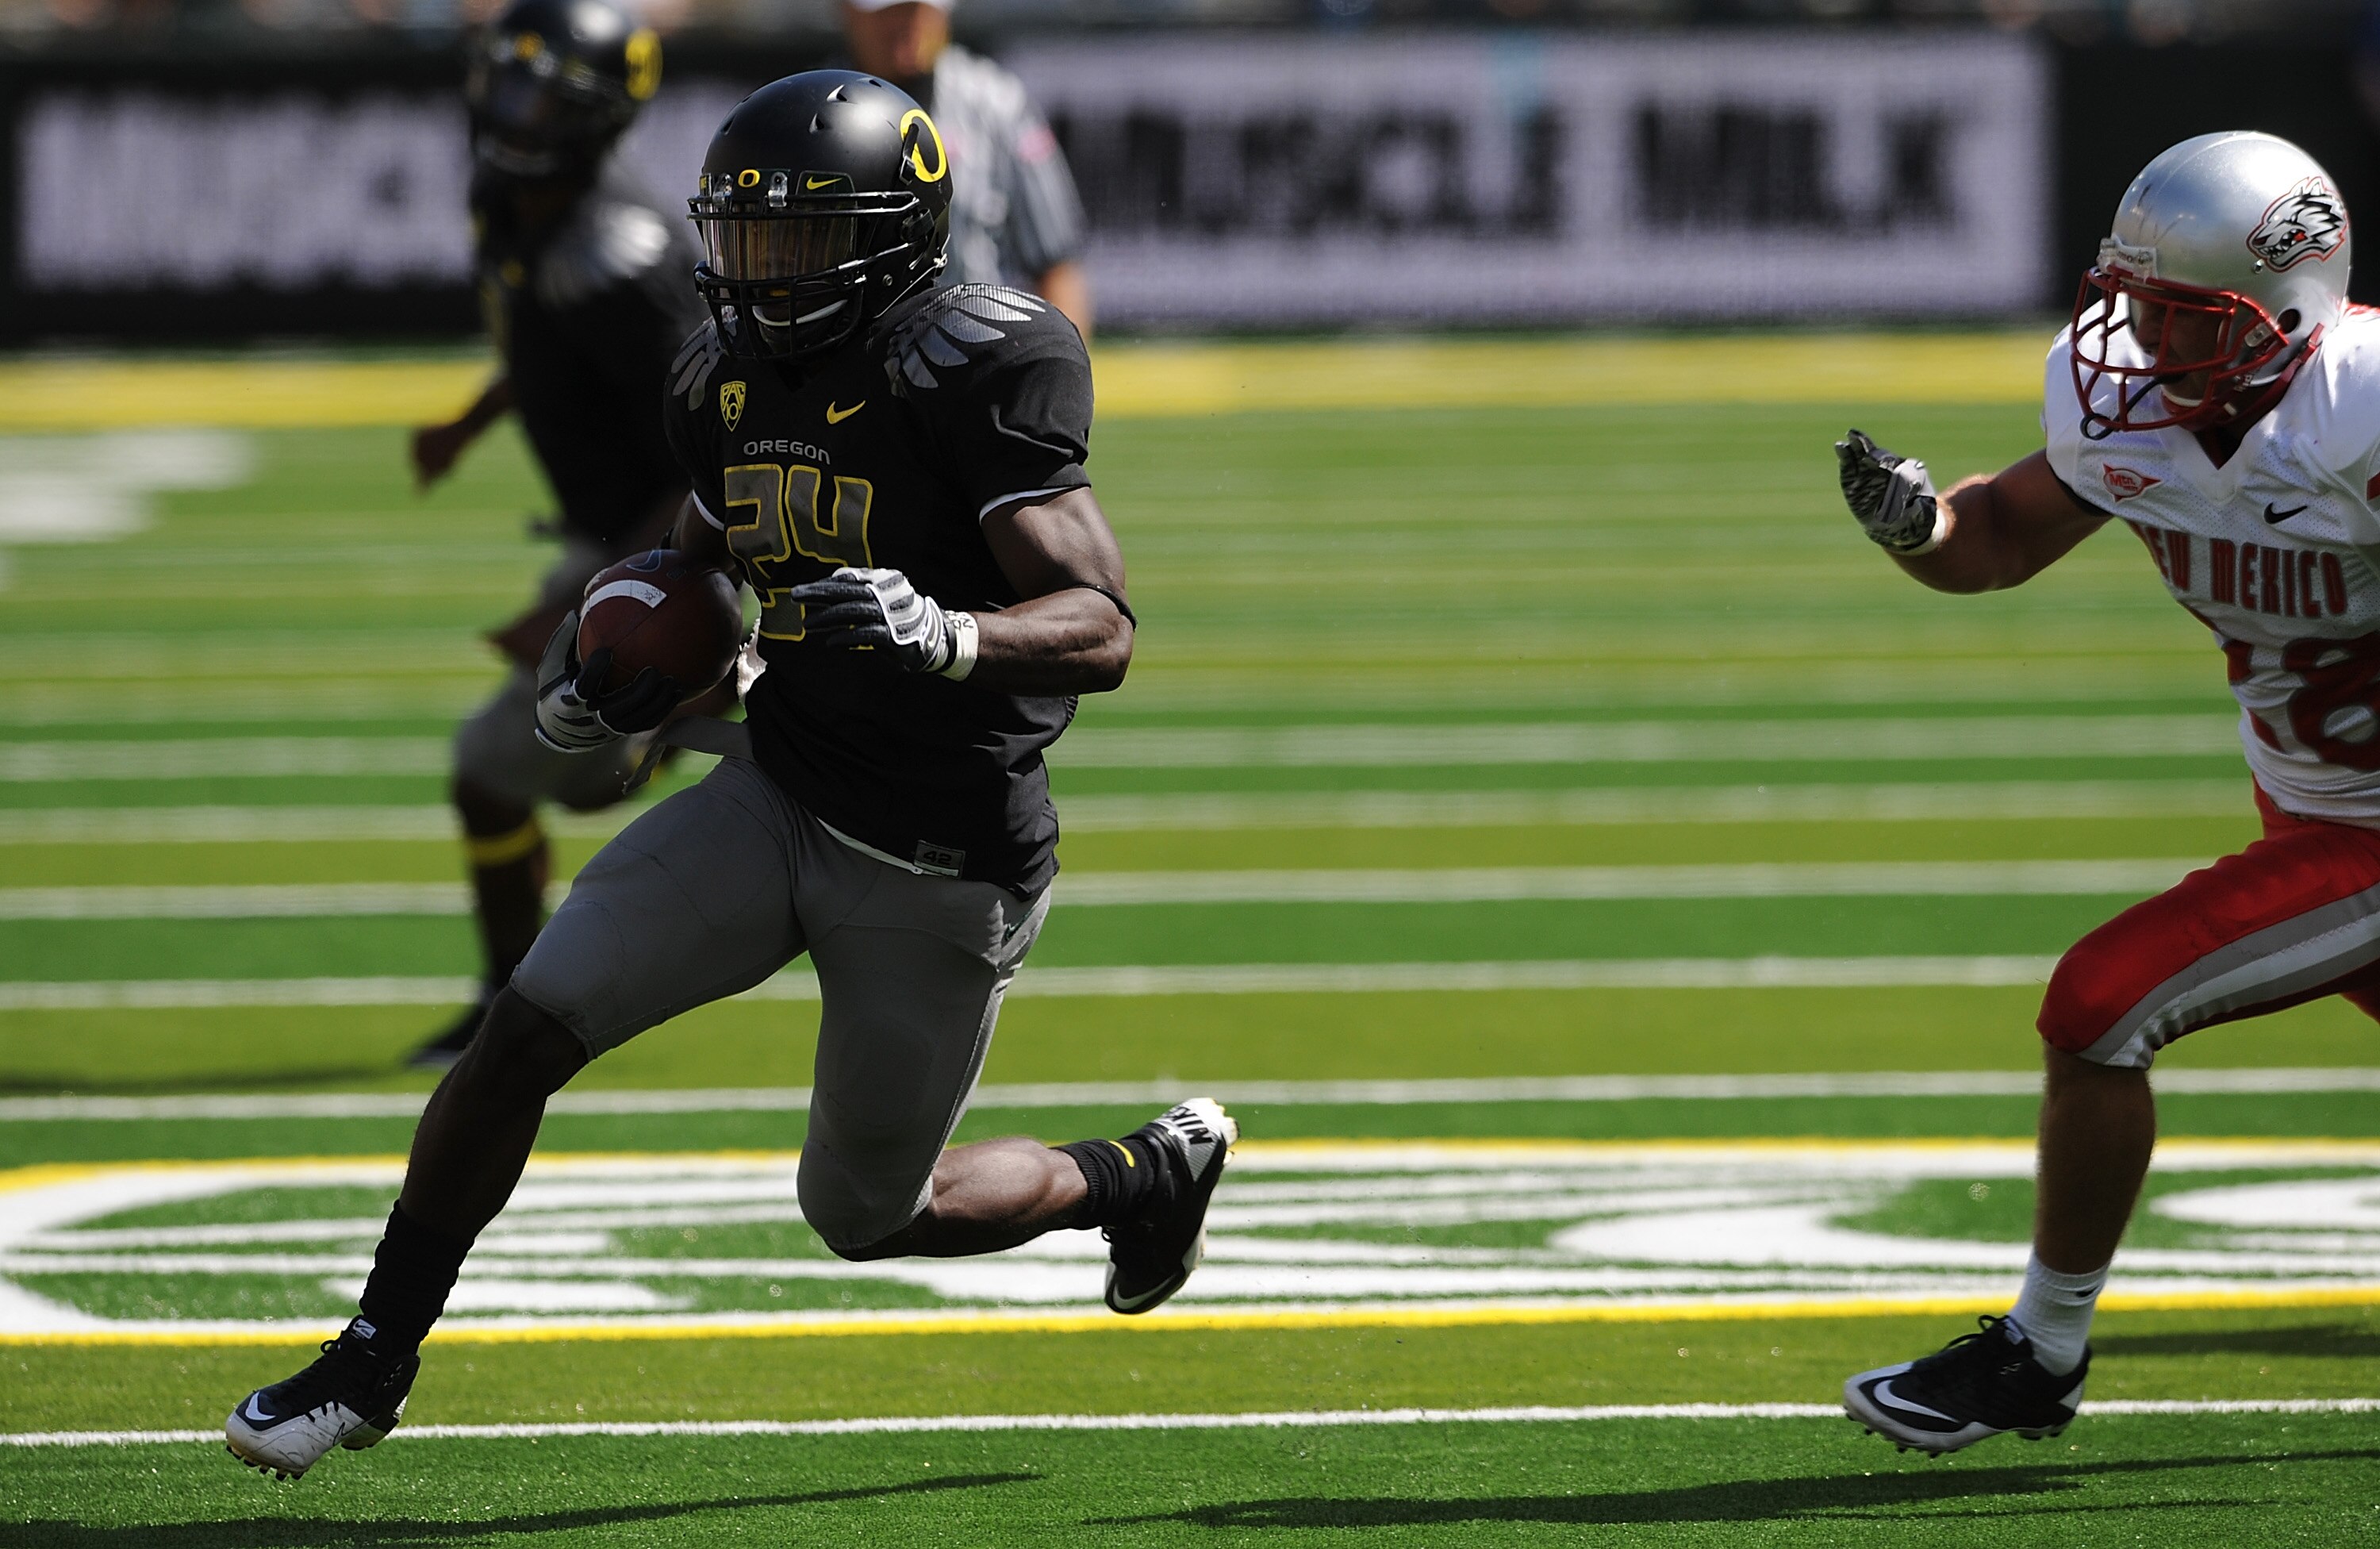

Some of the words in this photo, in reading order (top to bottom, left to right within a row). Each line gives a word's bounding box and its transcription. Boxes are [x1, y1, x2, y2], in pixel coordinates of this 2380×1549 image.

[738, 169, 760, 187] O
[721, 382, 746, 412] PAC
[726, 402, 739, 421] 10
[743, 440, 831, 465] OREGON
[724, 463, 873, 651] 24
[2128, 520, 2190, 591] EW
[2209, 537, 2347, 620] MEXICO
[923, 851, 953, 866] 42
